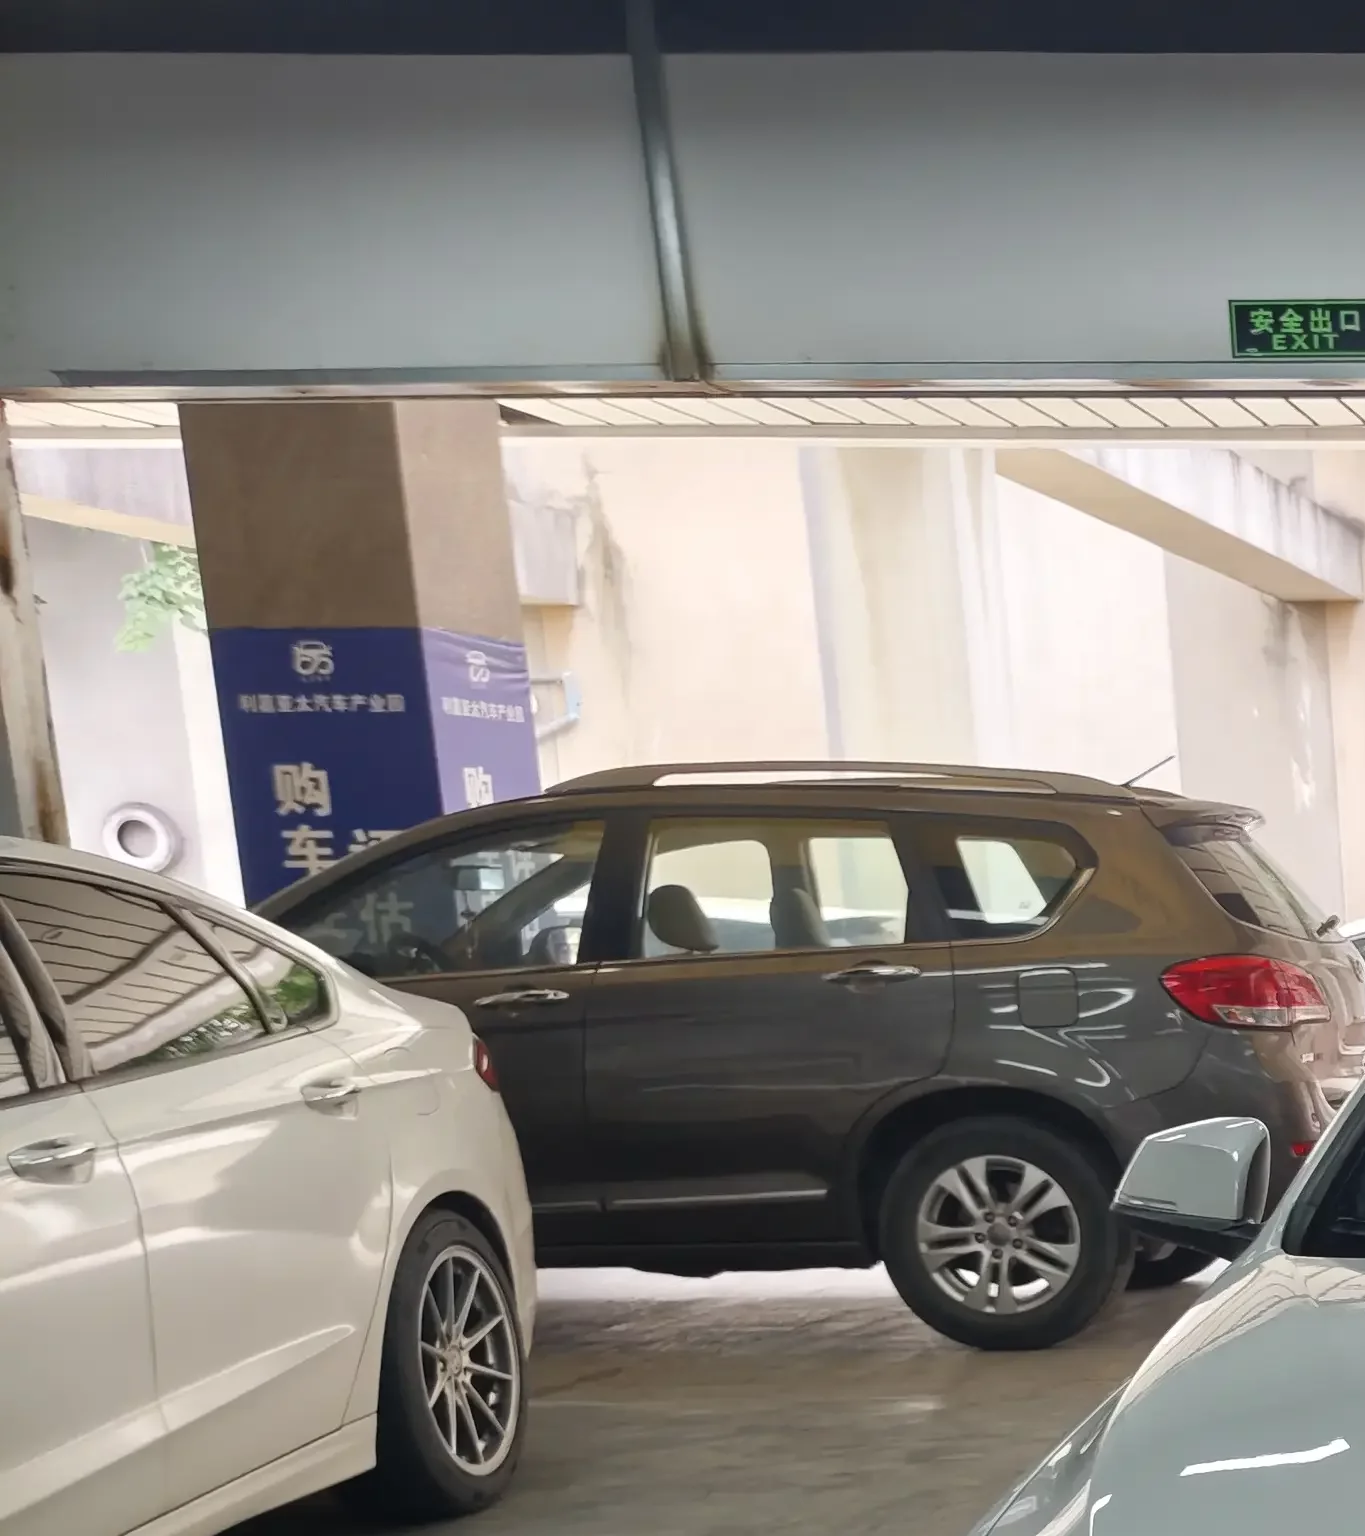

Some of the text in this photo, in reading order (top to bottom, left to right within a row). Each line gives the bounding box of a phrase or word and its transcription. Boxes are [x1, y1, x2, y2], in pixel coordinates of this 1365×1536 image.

[1249, 308, 1361, 335] 安全出口
[1272, 334, 1340, 350] EXIT
